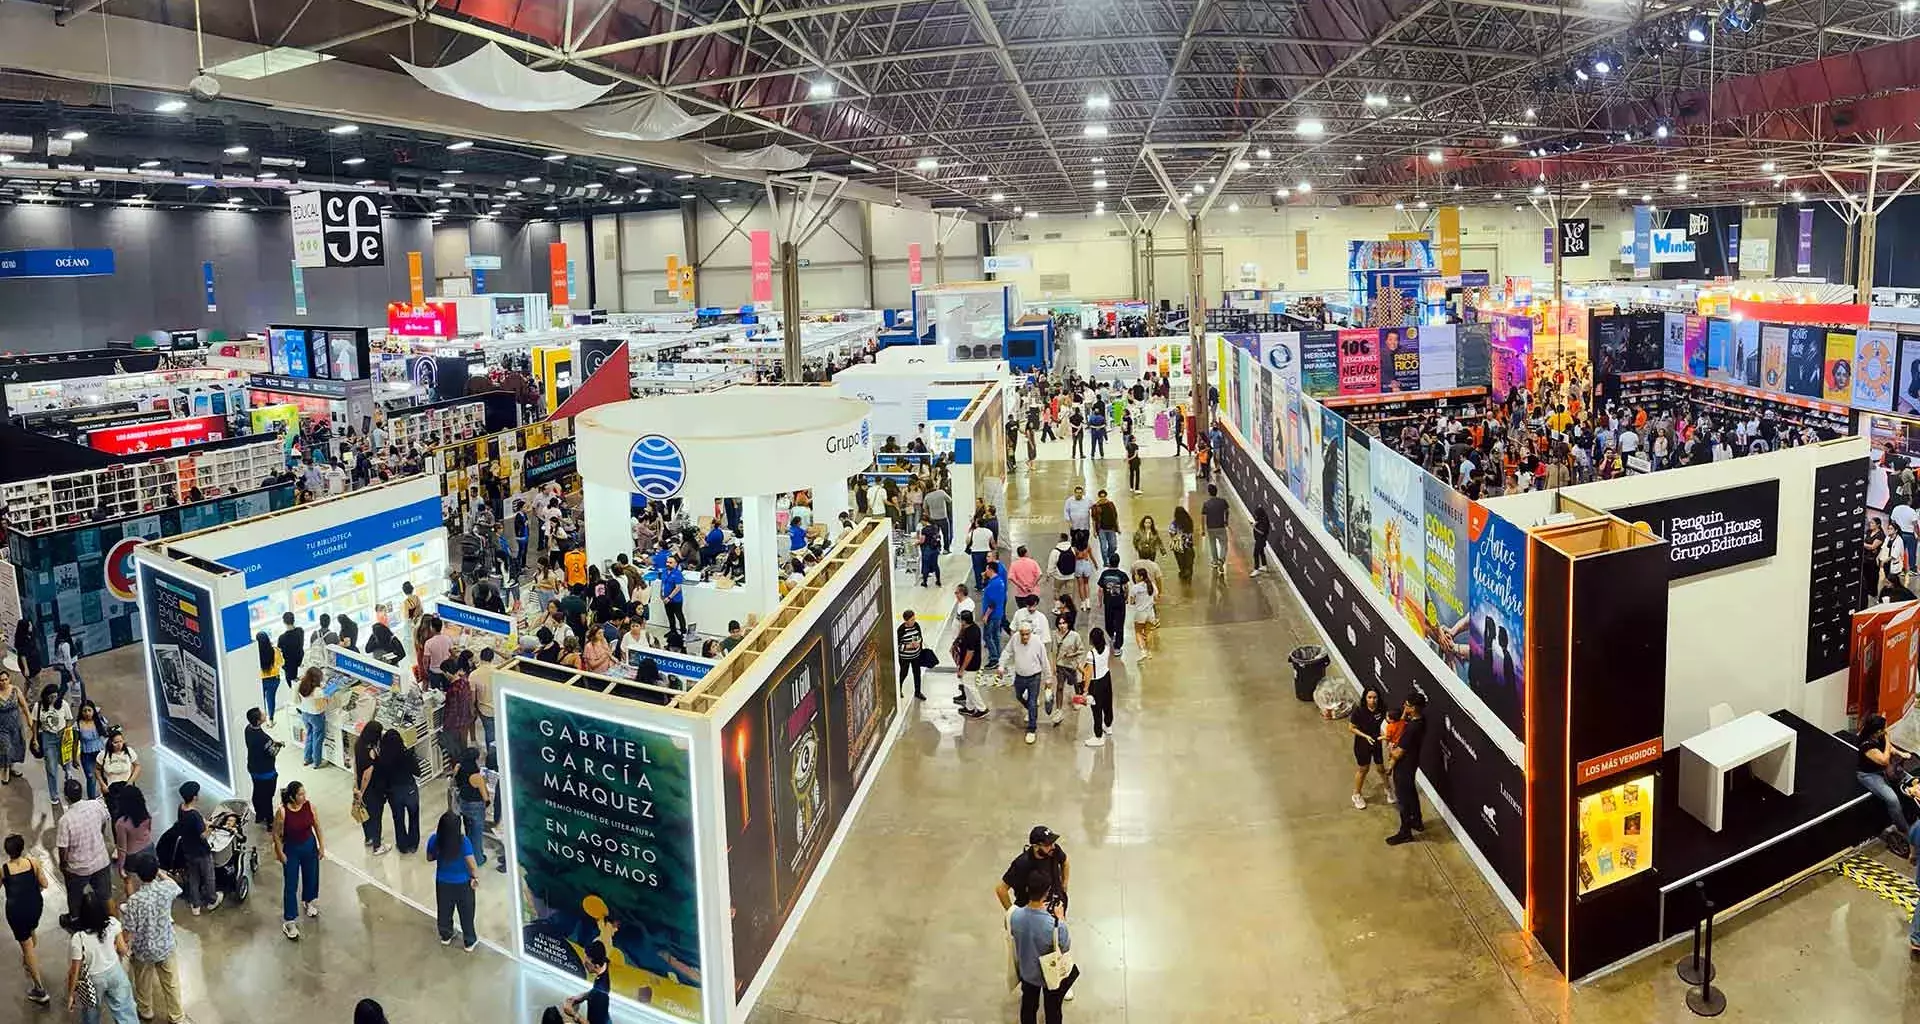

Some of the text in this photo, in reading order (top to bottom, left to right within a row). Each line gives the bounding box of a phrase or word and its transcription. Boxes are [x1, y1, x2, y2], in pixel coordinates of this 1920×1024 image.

[293, 204, 319, 220] EDUCAL
[55, 255, 89, 268] OCÉANO
[1304, 352, 1336, 360] HERIDAS
[1394, 360, 1418, 370] RICO
[826, 432, 859, 453] Grupo
[1671, 518, 1761, 546] Random House
[1672, 511, 1724, 531] Penguin
[312, 542, 347, 558] SALUDABLE
[317, 531, 352, 548] BIBLIOTECA
[1426, 531, 1455, 567] GANAR
[1480, 524, 1517, 571] Antes
[1671, 529, 1763, 561] Grupo Editorial
[1473, 552, 1524, 616] diciembre
[157, 589, 178, 609] JOSÉ
[160, 619, 202, 648] PACHECO
[539, 720, 652, 763] GABRIEL
[541, 746, 653, 791] GARCÍA
[1585, 746, 1657, 776] LOS MÁS VENDIDOS
[544, 775, 654, 819] MÁRQUEZ
[545, 799, 656, 839] PREMIO NOBEL DE LITERATURA
[546, 818, 657, 864] EN AGOSTO
[547, 840, 658, 887] NOS VEMOS
